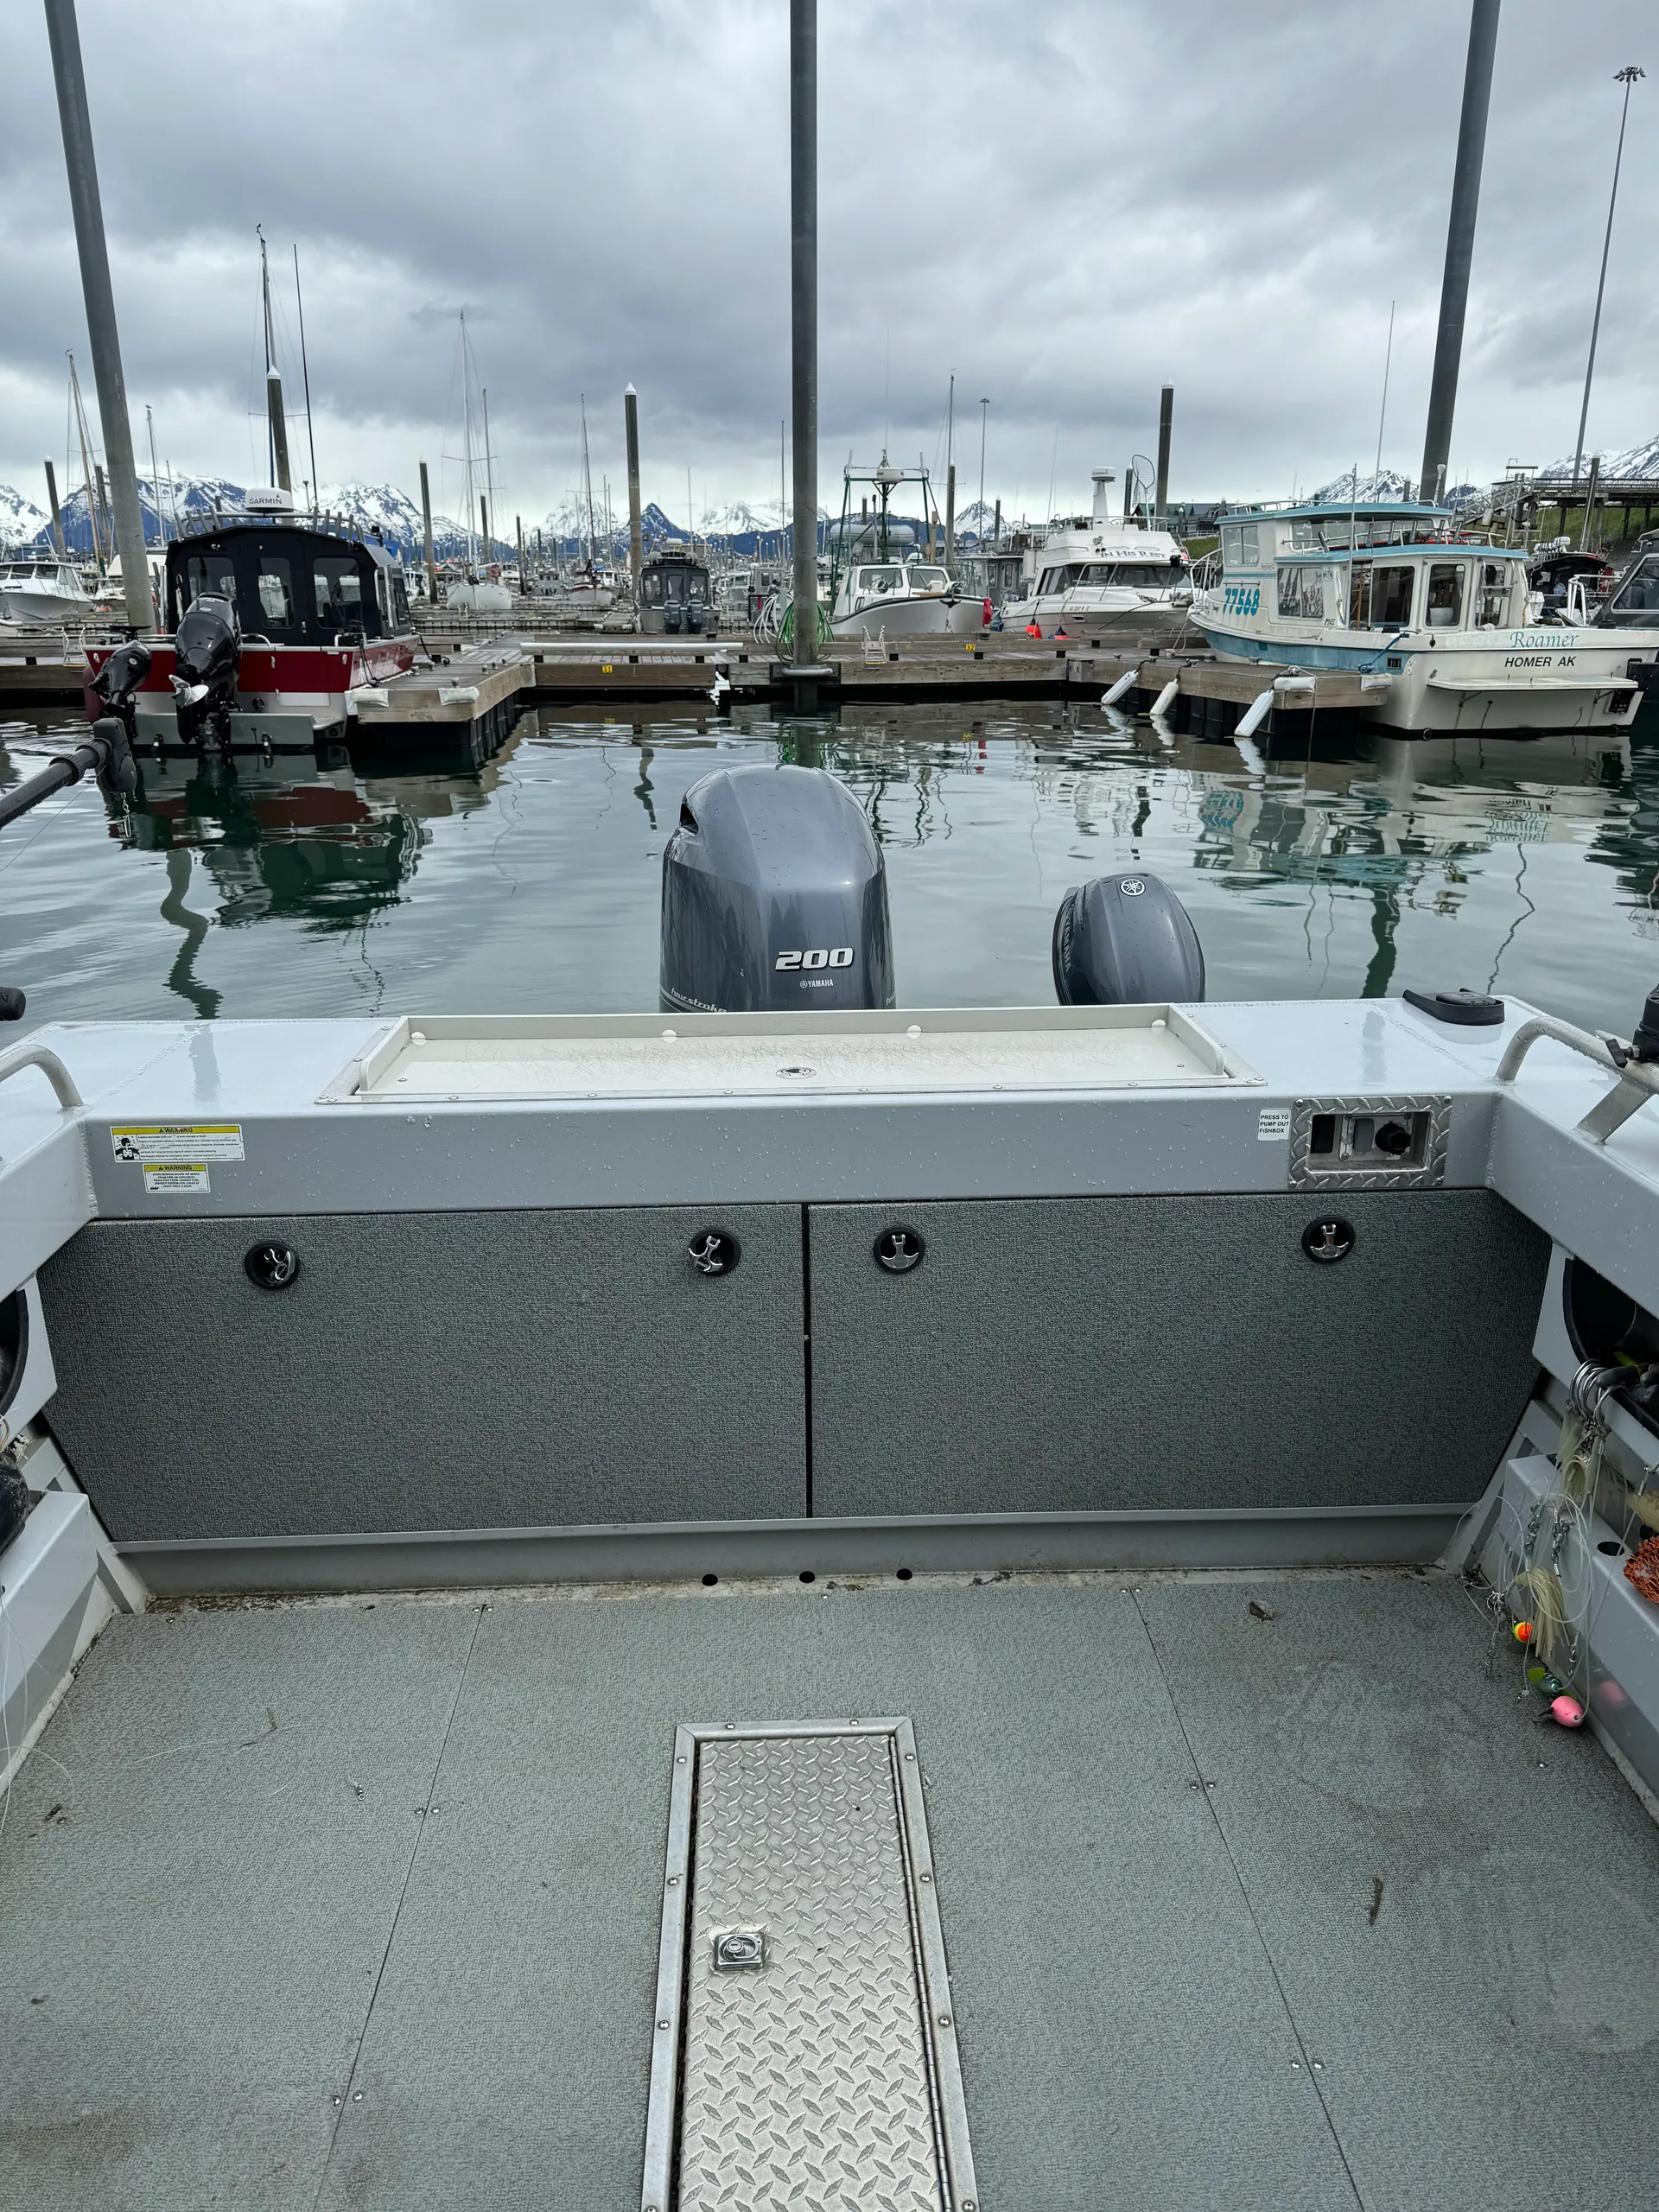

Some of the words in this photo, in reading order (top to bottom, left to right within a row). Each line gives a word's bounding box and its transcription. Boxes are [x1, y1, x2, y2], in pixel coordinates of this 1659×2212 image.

[1223, 588, 1260, 616] 77568
[1510, 631, 1579, 648] Roamer
[1504, 657, 1552, 667] HOMER
[1557, 656, 1577, 667] AK
[775, 947, 854, 970] 200
[808, 979, 834, 988] YAMAHA
